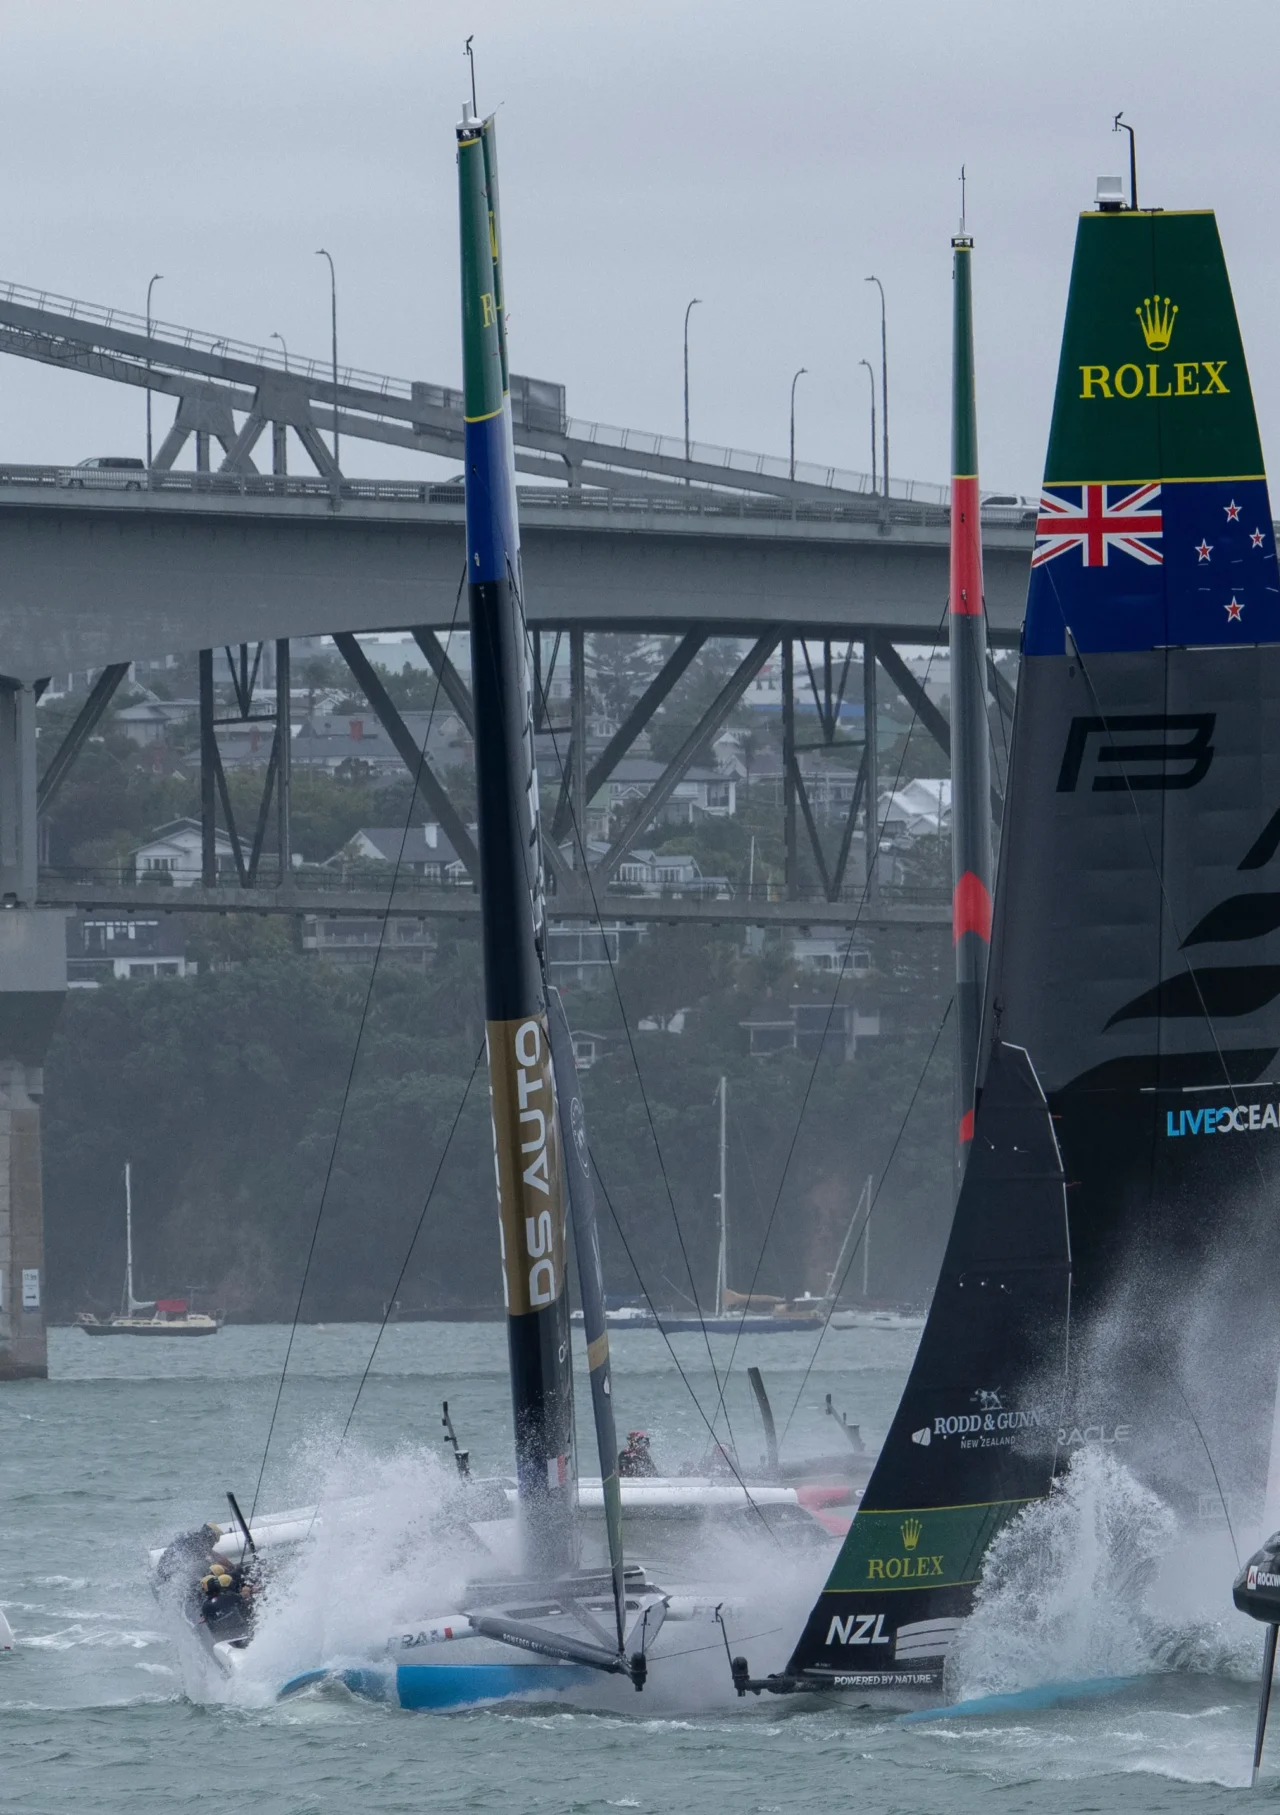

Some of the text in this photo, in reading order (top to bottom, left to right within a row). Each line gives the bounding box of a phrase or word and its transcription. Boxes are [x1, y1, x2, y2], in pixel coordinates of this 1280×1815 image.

[1079, 361, 1231, 399] ROLEX
[525, 1210, 556, 1306] DS
[934, 1410, 1041, 1435] RODD & GUNN
[961, 1436, 1016, 1449] NEW ZEALAND
[1057, 1424, 1133, 1446] RACLE
[867, 1555, 944, 1579] ROLEX
[825, 1614, 890, 1645] NZL
[834, 1676, 880, 1686] POWERED
[881, 1675, 894, 1685] BY
